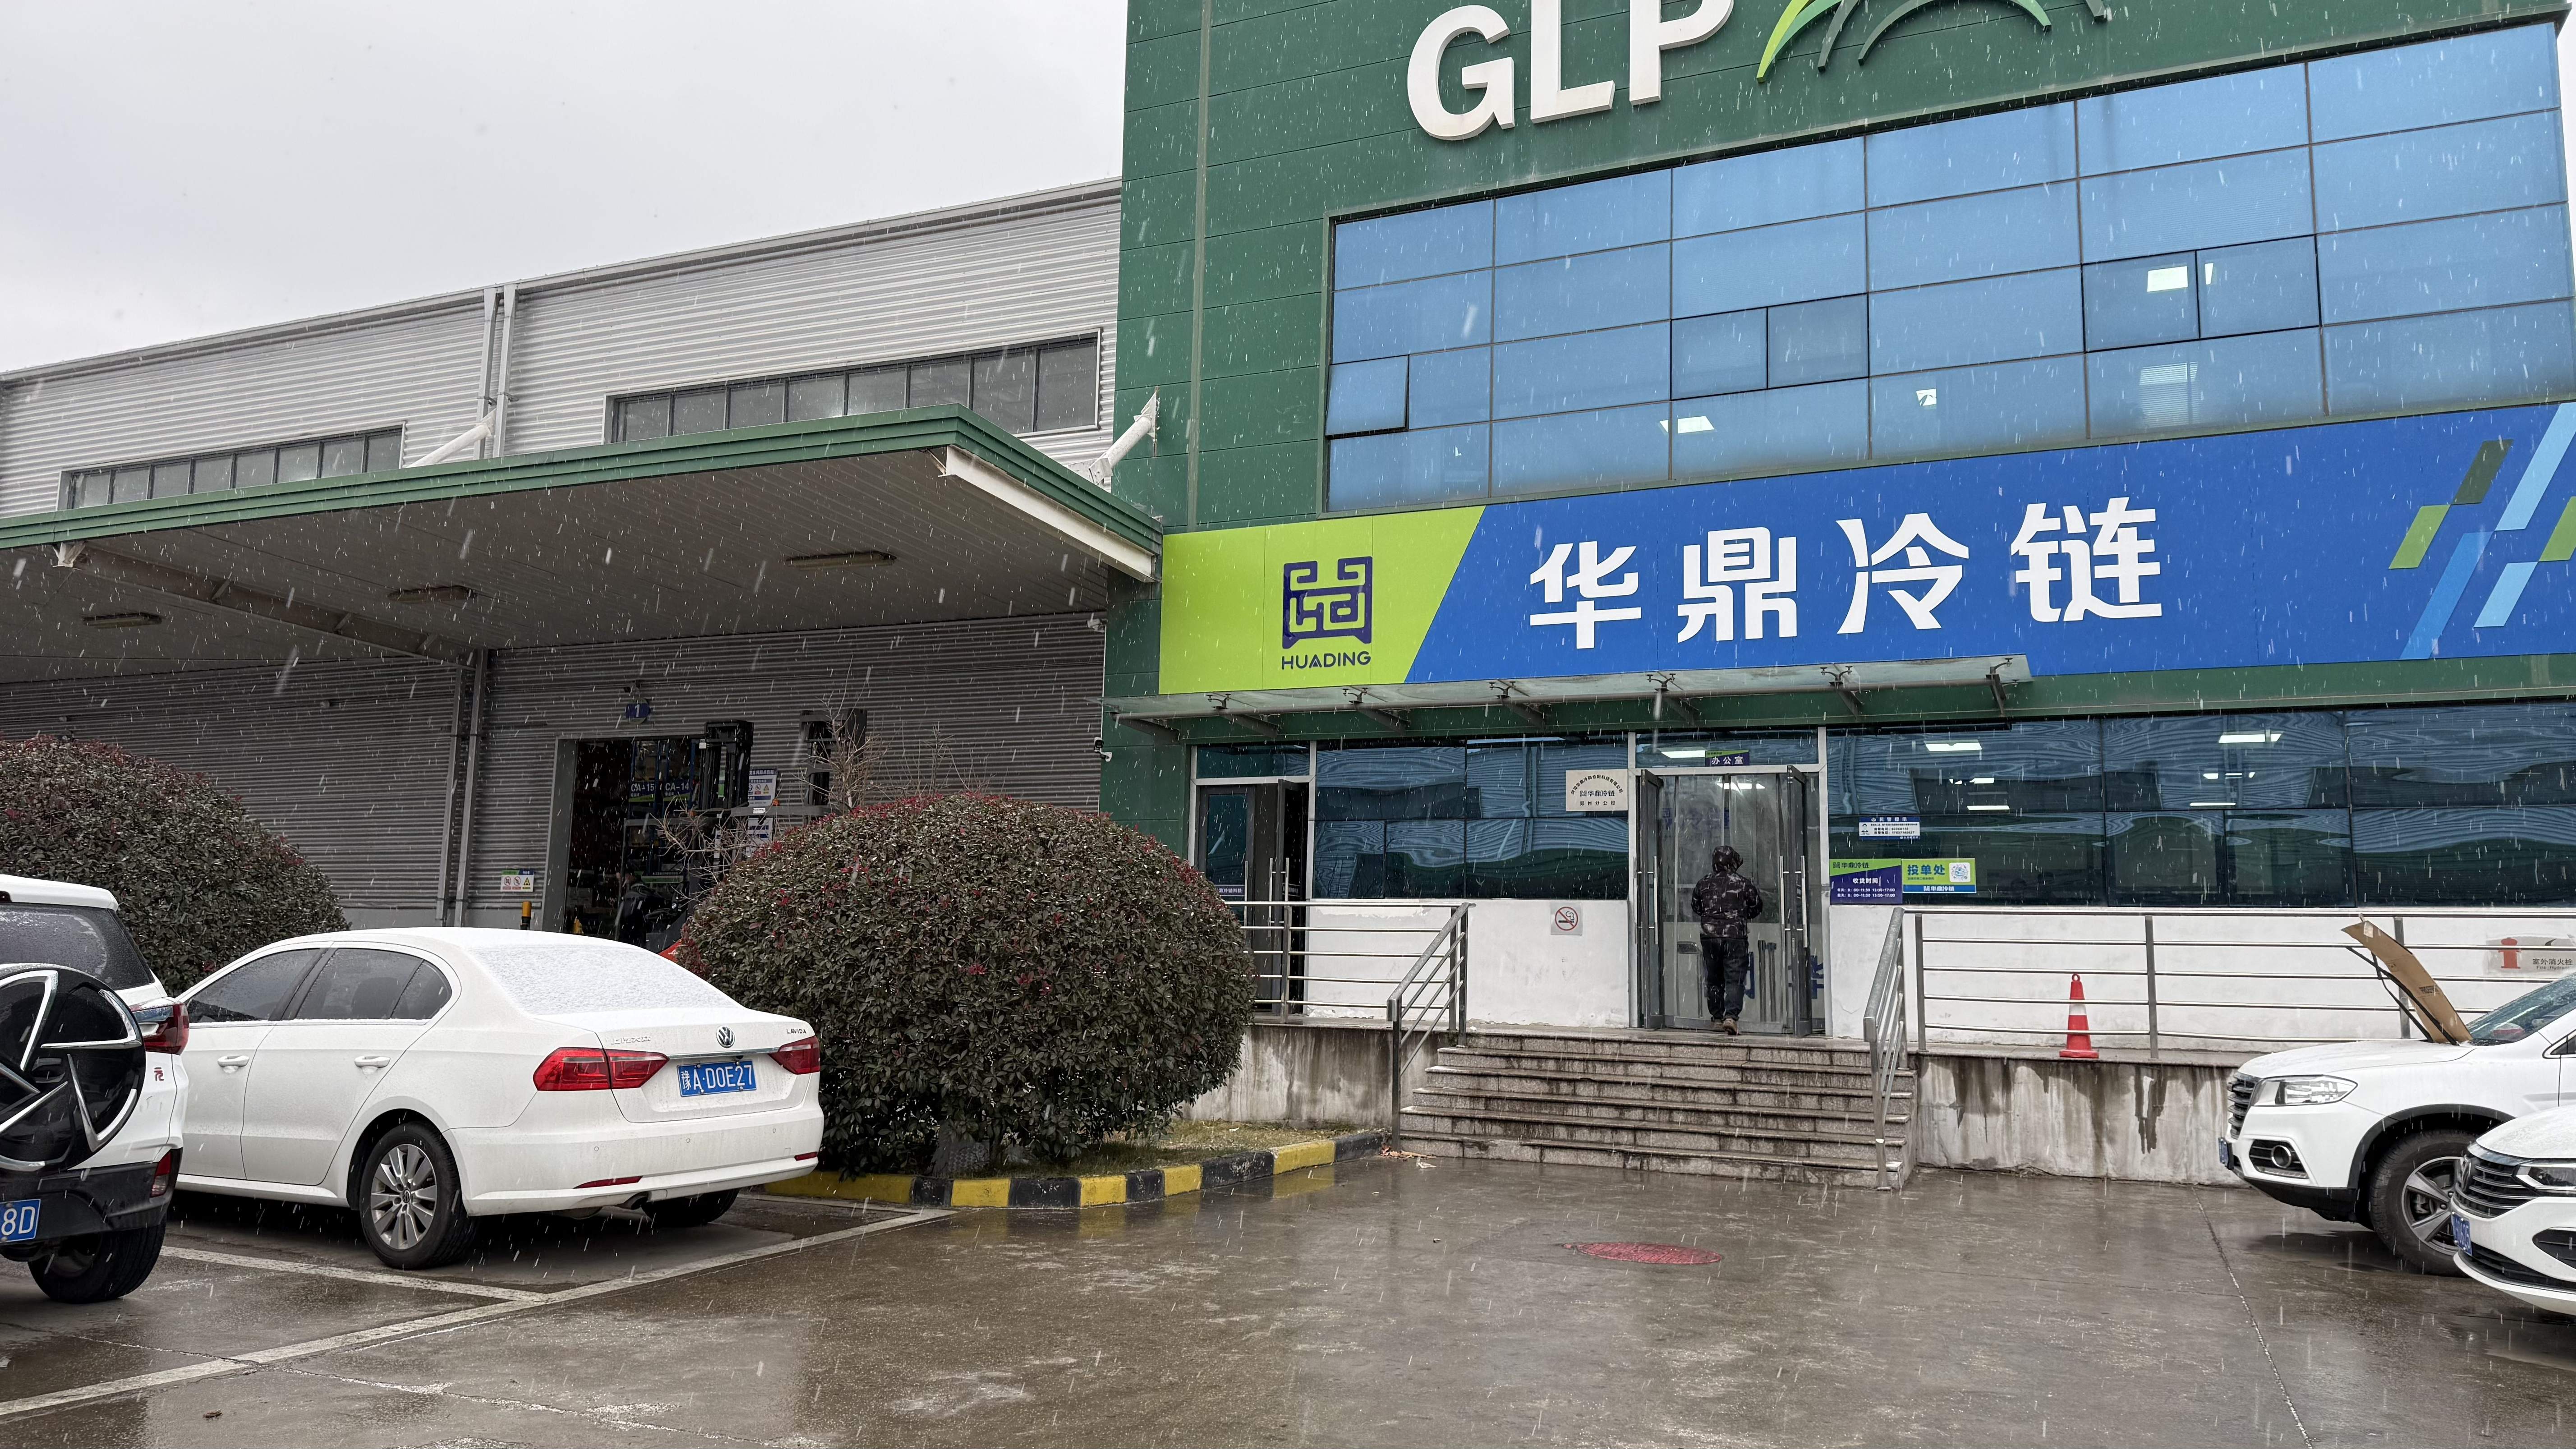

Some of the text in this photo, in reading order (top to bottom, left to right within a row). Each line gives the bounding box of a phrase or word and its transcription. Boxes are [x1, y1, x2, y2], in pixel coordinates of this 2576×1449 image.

[1407, 0, 1734, 141] GLP
[1530, 497, 2162, 649] 华鼎冷链
[1282, 651, 1371, 670] HUADING
[635, 704, 640, 718] 1
[1711, 756, 1743, 764] 办公室
[631, 783, 654, 791] CA-15
[665, 782, 689, 791] CA-14
[154, 1067, 165, 1081] 元
[1, 1206, 36, 1236] 8D
